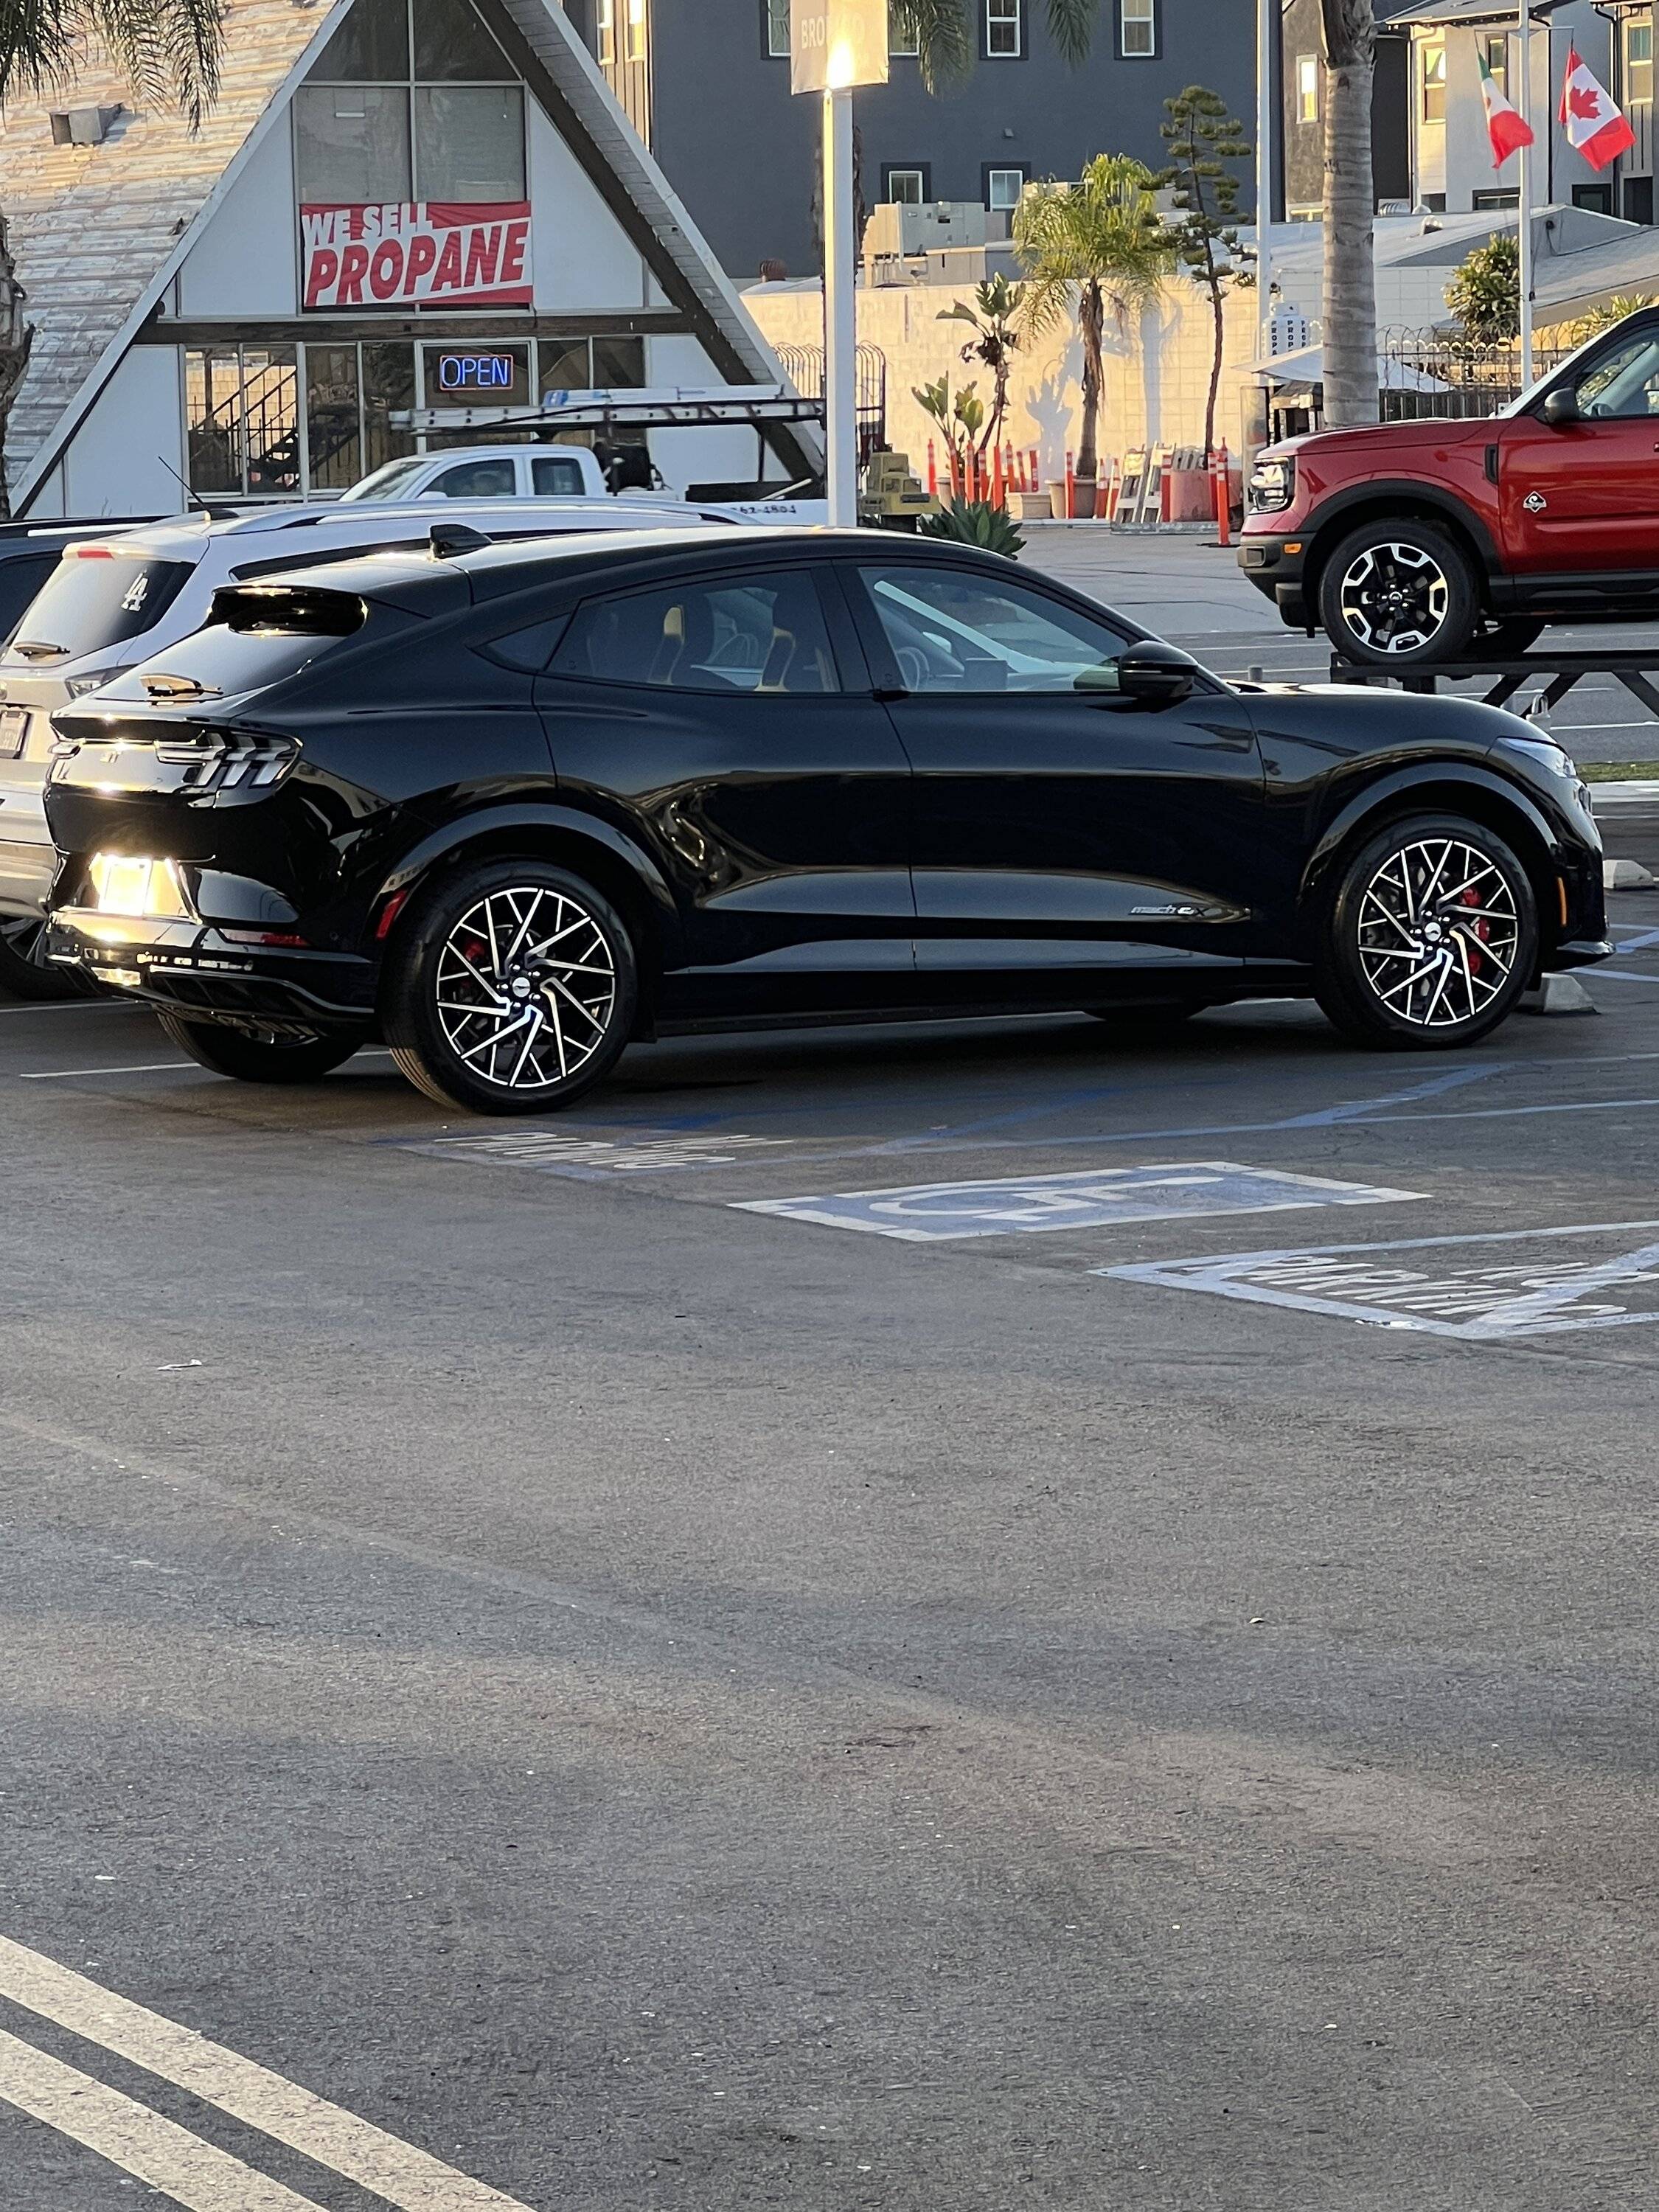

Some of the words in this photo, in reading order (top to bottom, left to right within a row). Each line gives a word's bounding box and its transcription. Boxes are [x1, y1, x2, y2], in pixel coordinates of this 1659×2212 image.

[302, 209, 352, 246] WE
[361, 202, 434, 238] SELL
[305, 221, 529, 307] PROPANE
[442, 358, 508, 386] OPEN
[120, 567, 148, 611] LA
